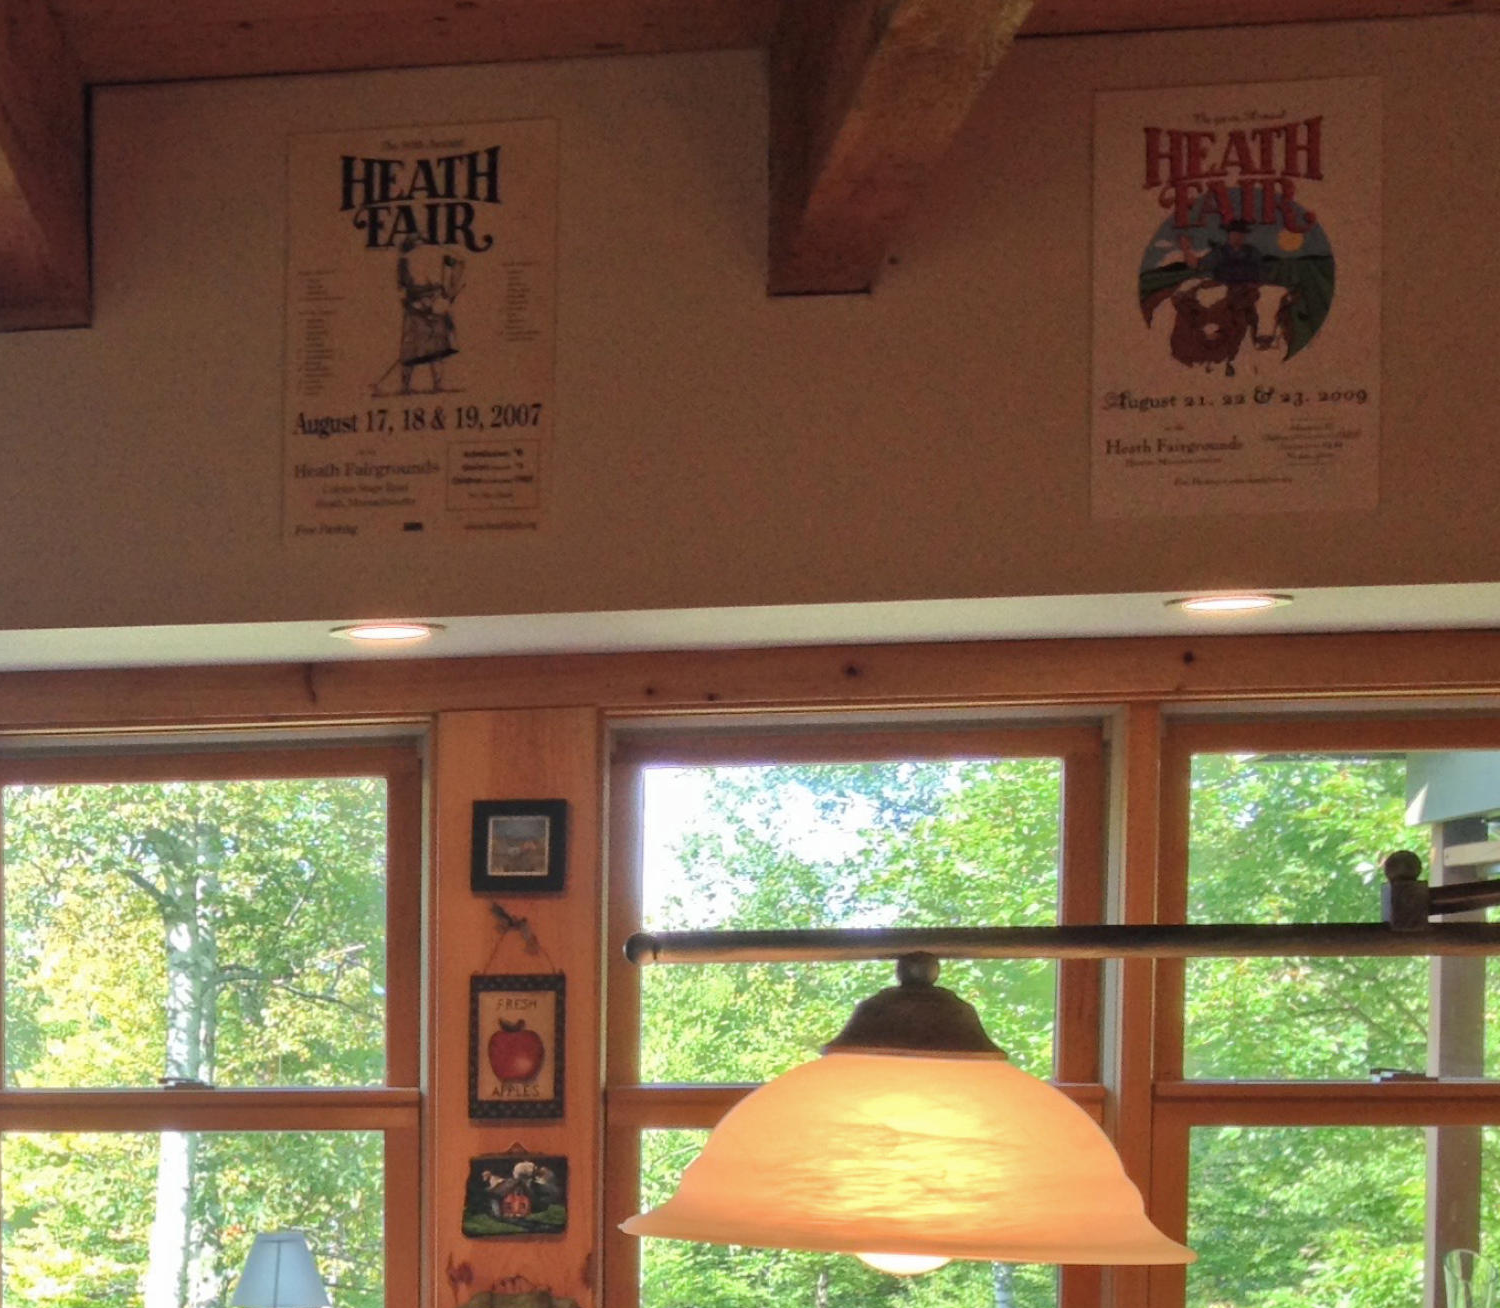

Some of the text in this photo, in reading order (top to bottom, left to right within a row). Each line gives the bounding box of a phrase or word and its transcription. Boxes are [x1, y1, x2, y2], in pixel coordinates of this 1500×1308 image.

[1143, 115, 1324, 190] HEATH
[340, 145, 501, 212] HEATH
[1158, 178, 1316, 233] FAIR
[353, 202, 493, 253] FAIR
[1101, 391, 1177, 412] August
[1222, 393, 1246, 405] 22
[1253, 385, 1276, 405] &
[1318, 388, 1368, 405] 2009
[293, 403, 542, 438] August 17, 18 & 19, 2007
[1105, 435, 1243, 455] Heath Fairgrounds
[294, 459, 440, 479] Heath Fairgrounds
[496, 998, 537, 1010] FRESH
[492, 1084, 540, 1098] APPLES
